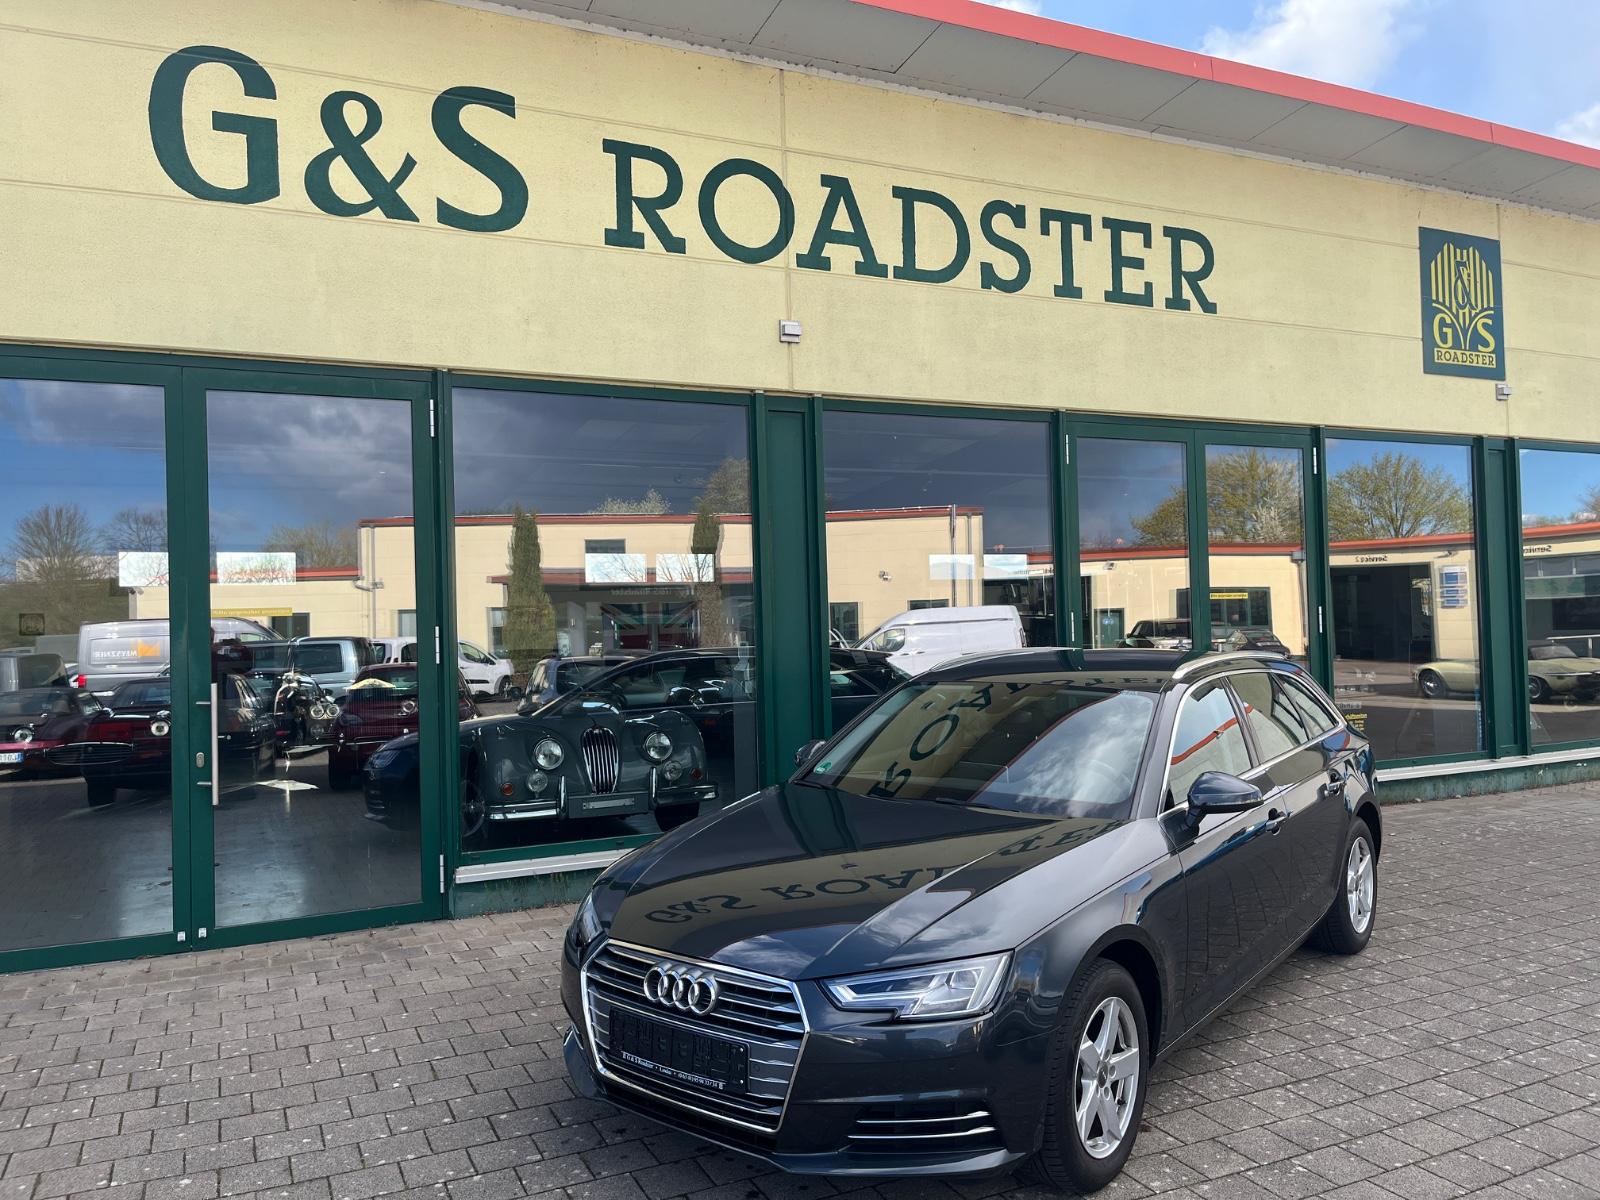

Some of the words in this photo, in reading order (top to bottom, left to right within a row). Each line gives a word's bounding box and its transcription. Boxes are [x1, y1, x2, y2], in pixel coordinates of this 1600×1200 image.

[148, 45, 529, 232] G&S
[602, 138, 1218, 314] ROADSTER
[1436, 349, 1495, 367] ROADSTER
